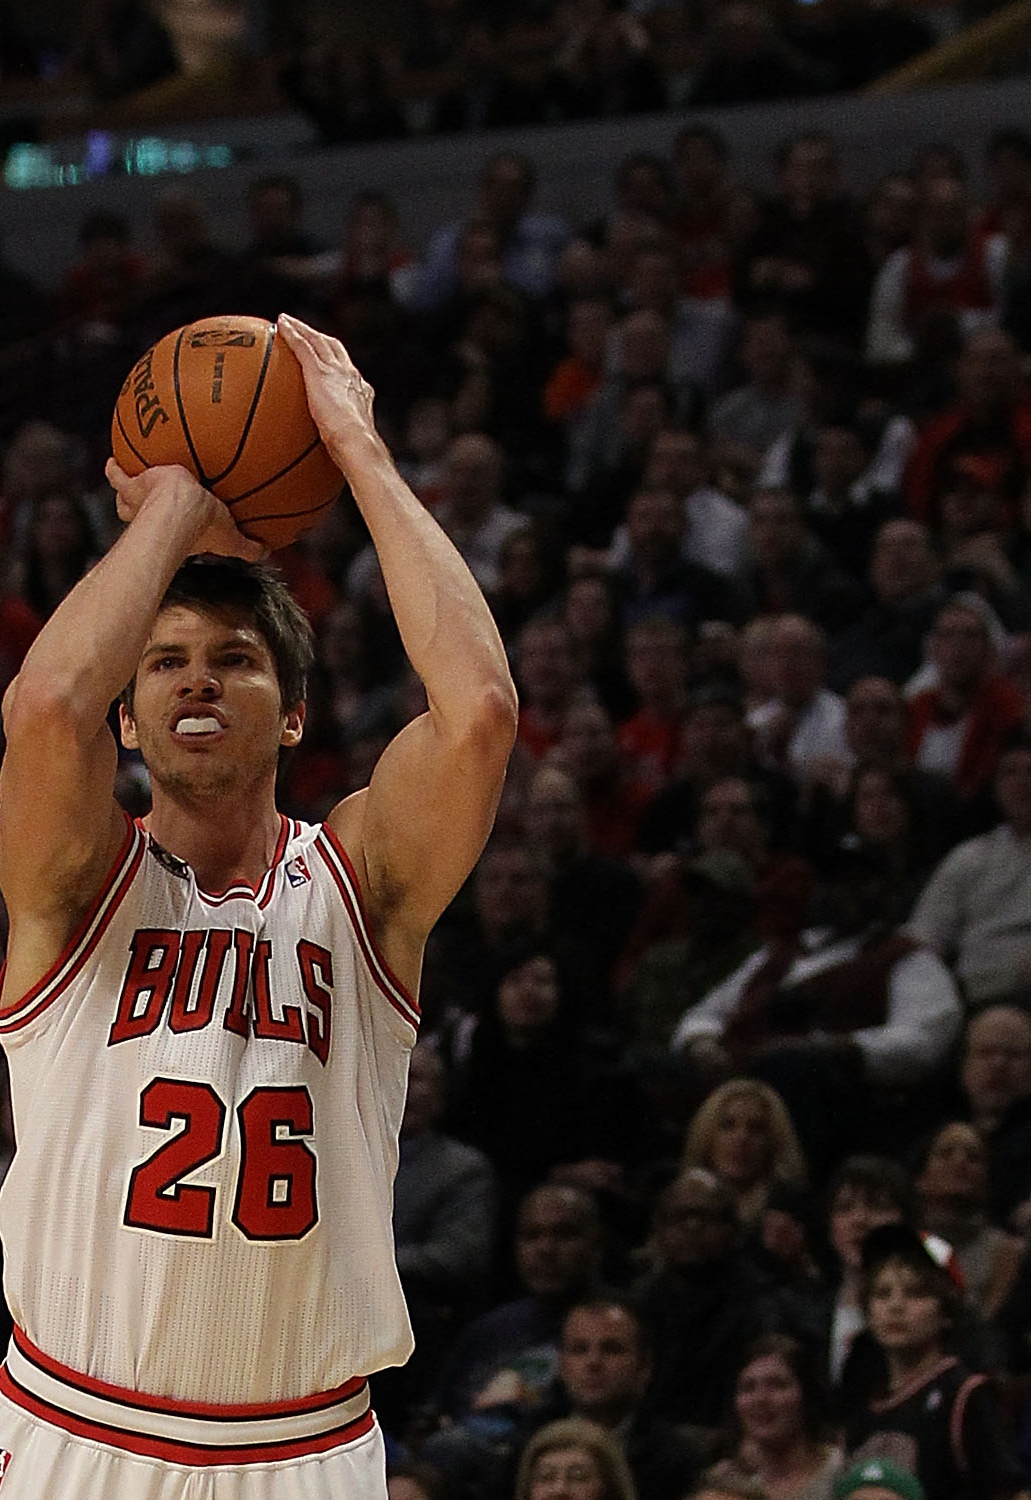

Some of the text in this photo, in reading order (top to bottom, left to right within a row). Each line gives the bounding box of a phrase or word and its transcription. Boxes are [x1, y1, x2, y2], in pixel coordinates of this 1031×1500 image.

[133, 349, 170, 438] SPAL
[108, 928, 333, 1067] BULLS
[123, 1076, 319, 1241] 26
